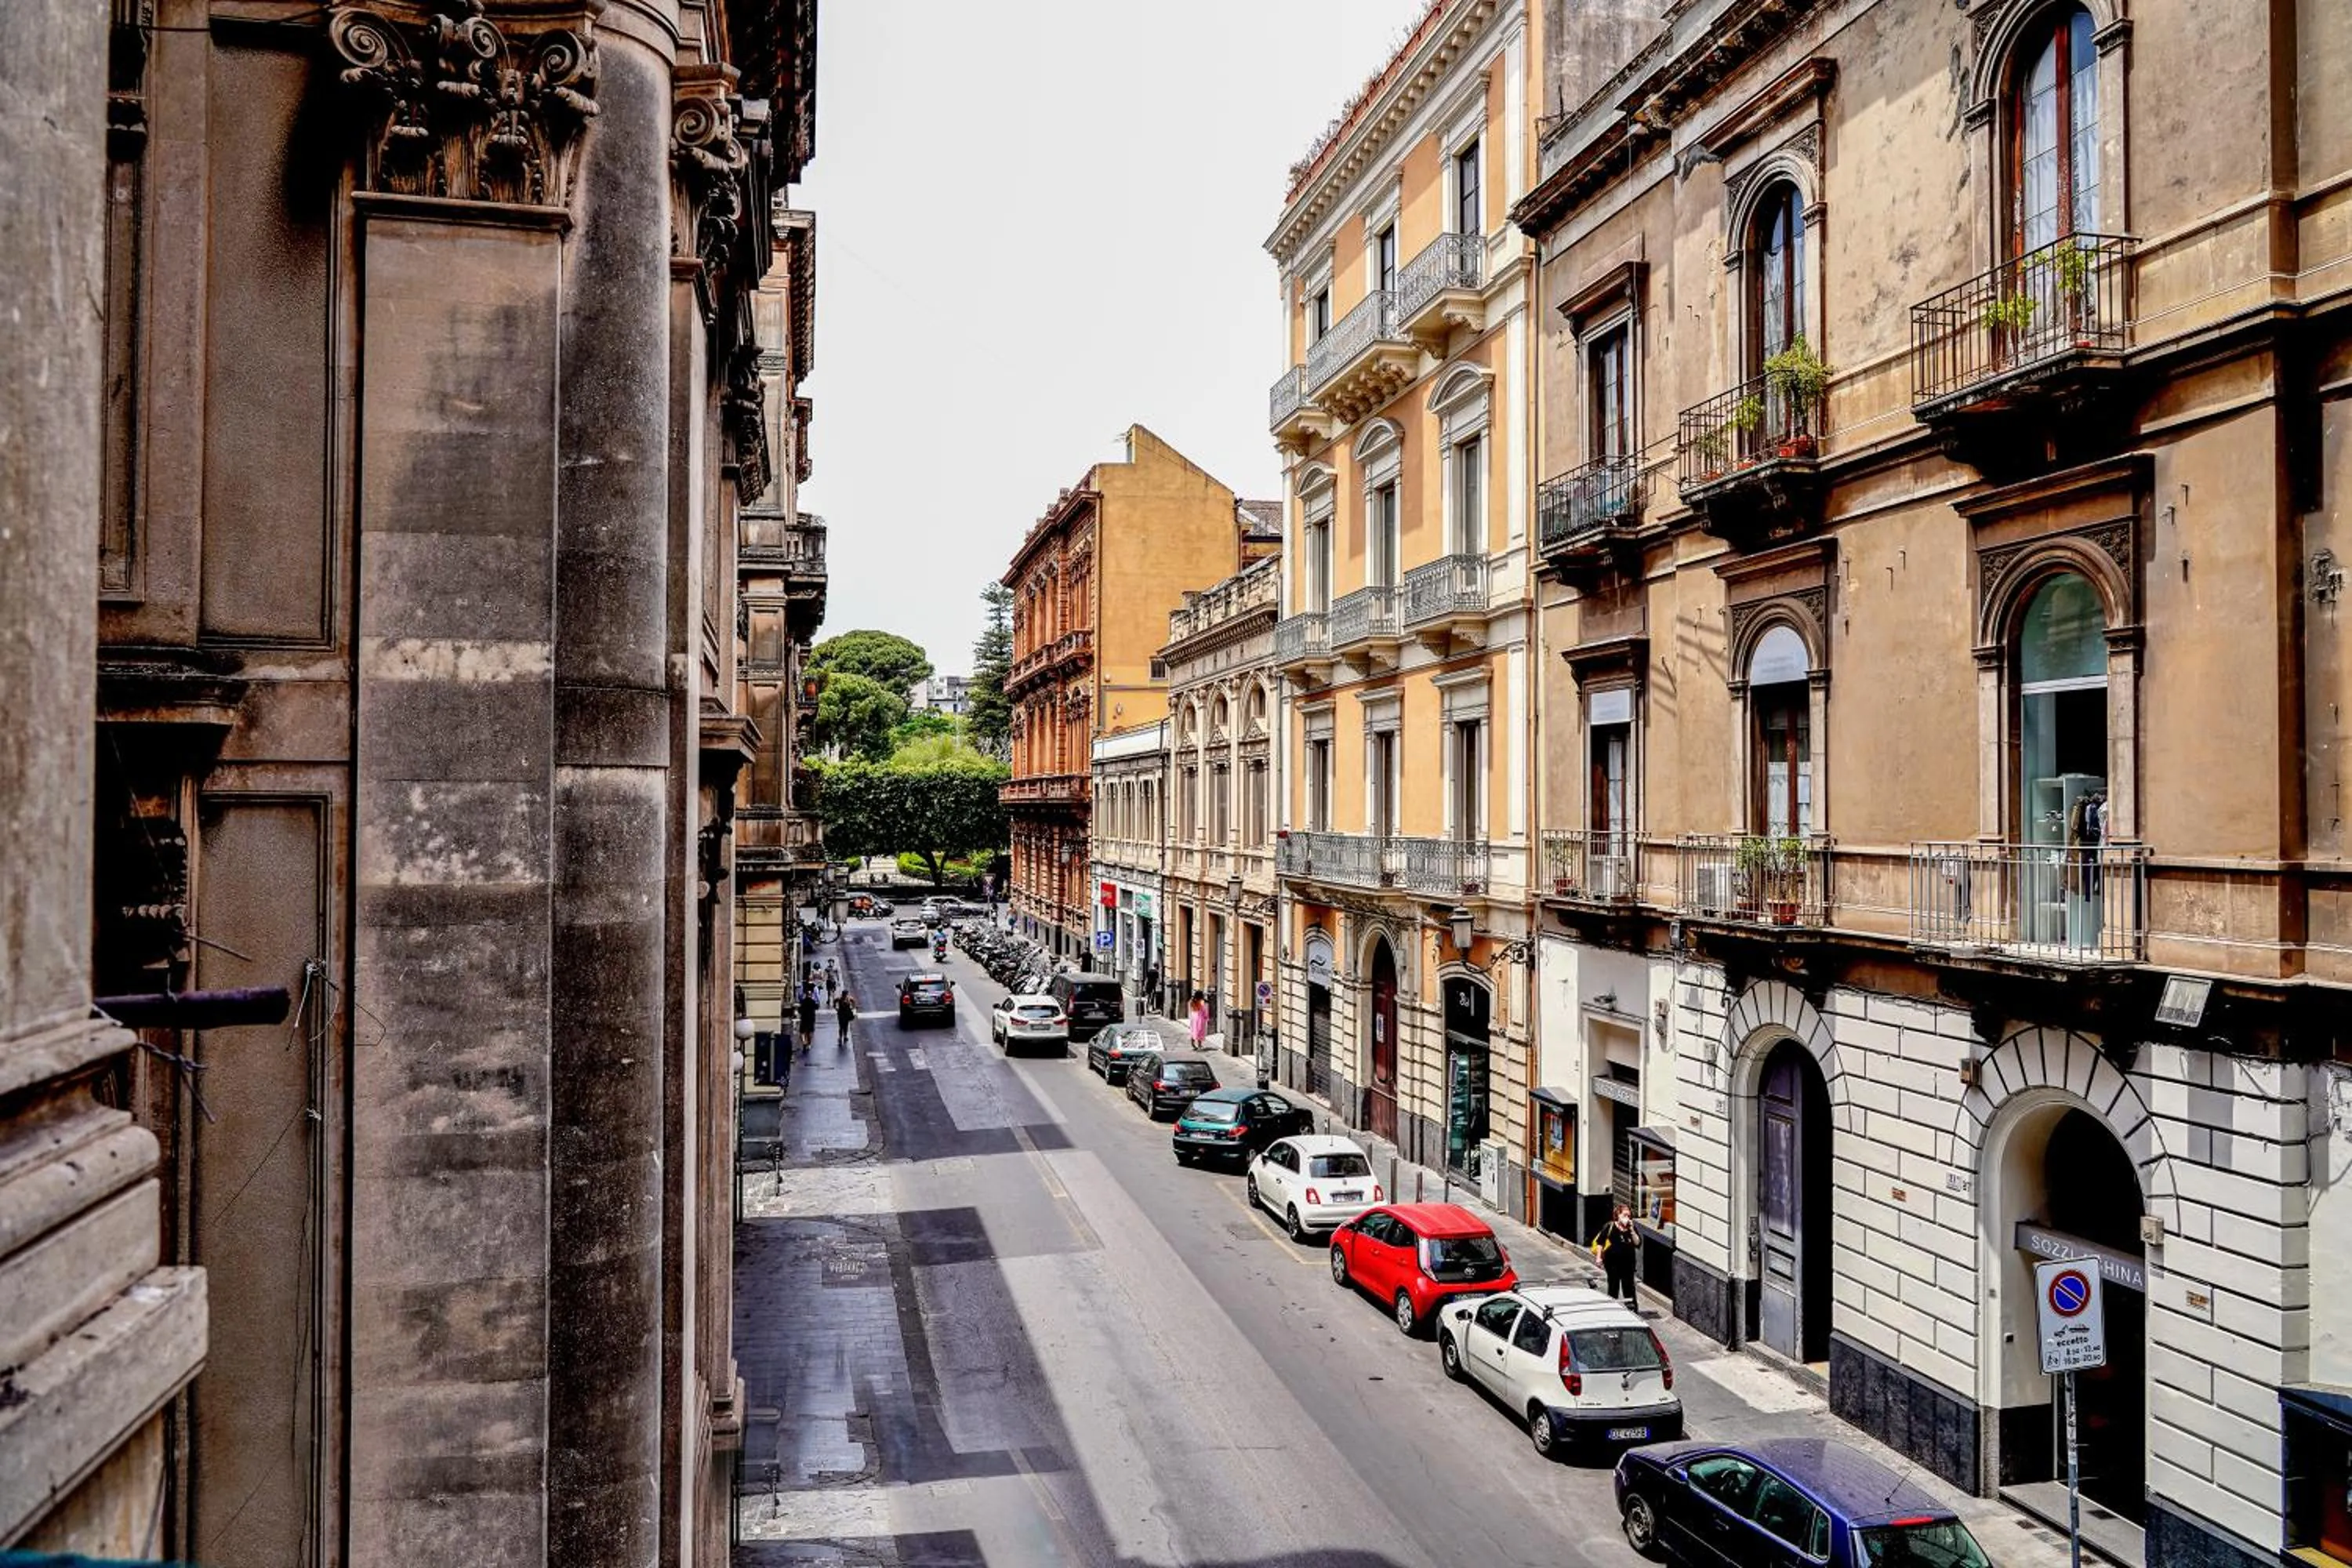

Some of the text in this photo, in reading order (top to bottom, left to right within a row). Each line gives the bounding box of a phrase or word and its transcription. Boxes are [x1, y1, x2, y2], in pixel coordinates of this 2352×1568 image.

[1100, 932, 1111, 948] P
[2031, 1235, 2074, 1259] SOZZI
[2056, 1336, 2089, 1347] eccetto
